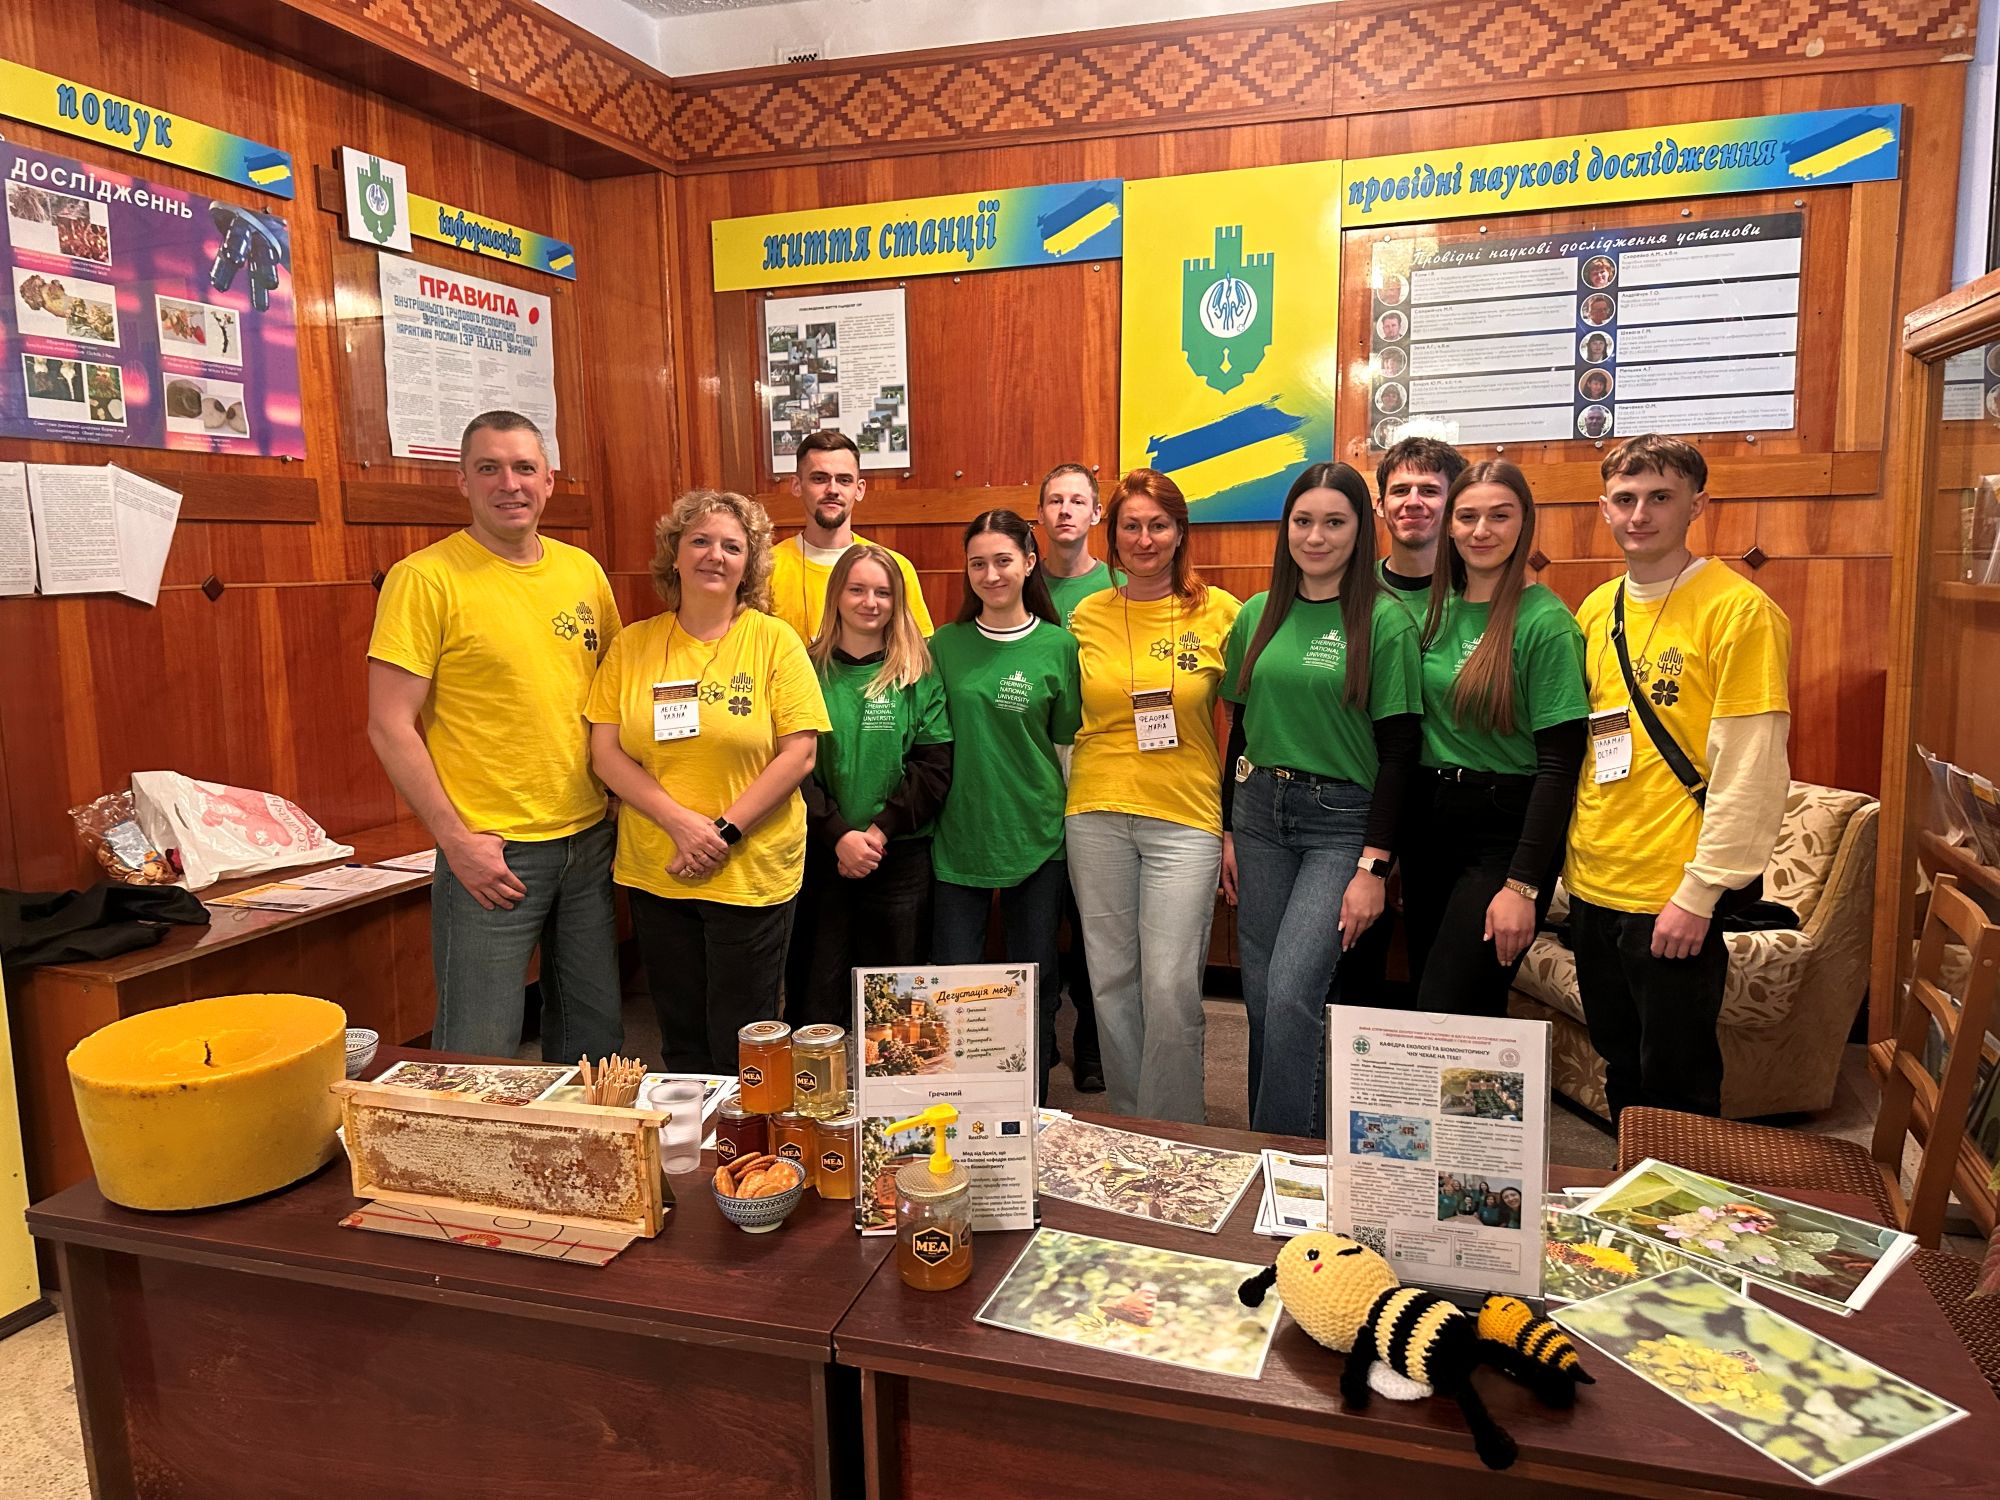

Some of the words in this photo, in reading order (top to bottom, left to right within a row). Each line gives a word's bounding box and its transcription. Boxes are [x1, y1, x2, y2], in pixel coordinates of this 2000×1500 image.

[57, 83, 172, 151] пошук
[1348, 161, 1464, 213] провідні
[1469, 149, 1581, 199] наукові
[1586, 138, 1777, 181] дослідження
[438, 207, 521, 258] інформація
[762, 224, 872, 270] життя
[879, 199, 1000, 262] станції
[1411, 244, 1481, 266] Провідні
[1489, 241, 1552, 259] наукові
[1560, 233, 1668, 253] дослідження
[1676, 223, 1761, 247] установи
[419, 274, 519, 318] ПРАВИЛА
[1306, 652, 1341, 662] UNIVERSITY
[1309, 645, 1340, 655] NATIONAL
[1657, 661, 1684, 676] ЧНУ
[730, 682, 753, 693] ЧНУ
[999, 687, 1028, 697] NATIONAL
[997, 693, 1030, 704] UNIVERSITY
[936, 988, 989, 1003] Дегустація
[991, 984, 1016, 997] меду:
[1379, 1041, 1406, 1050] КАФЕДРА
[1406, 1043, 1432, 1052] ЕКОЛОГІЇ
[928, 1090, 963, 1099] Гречаний
